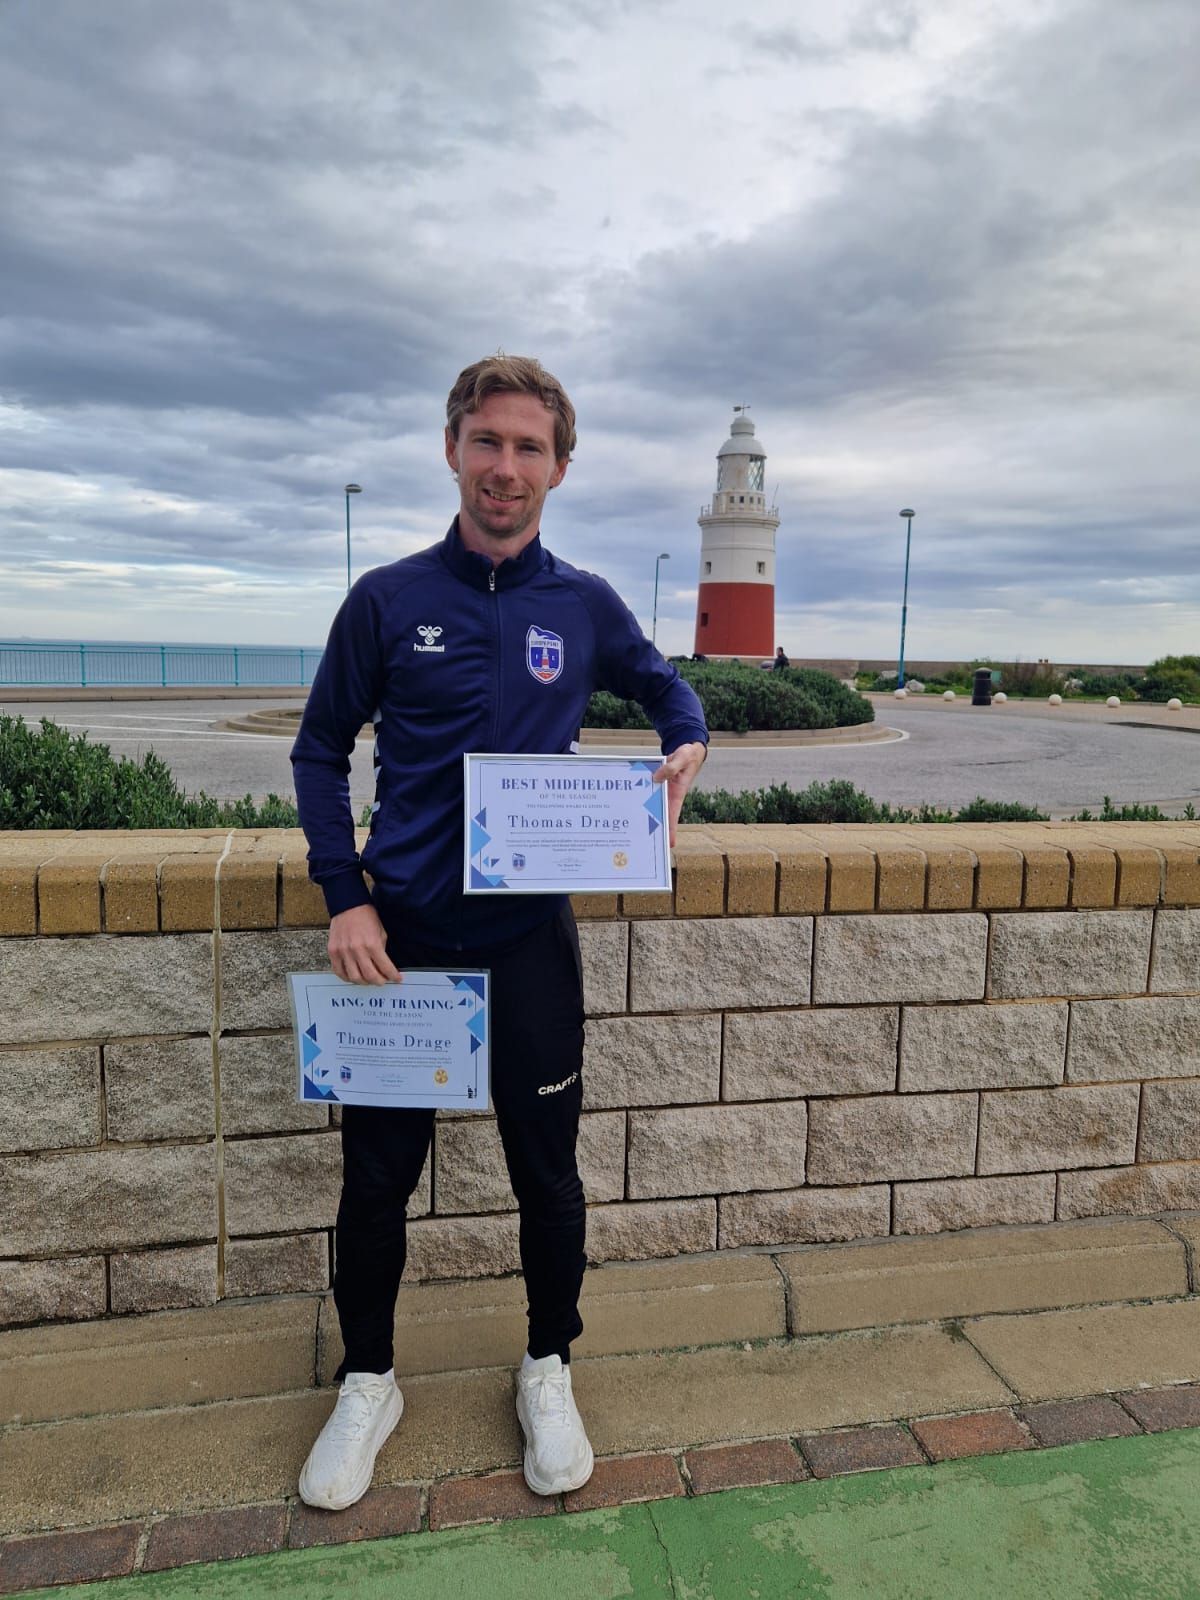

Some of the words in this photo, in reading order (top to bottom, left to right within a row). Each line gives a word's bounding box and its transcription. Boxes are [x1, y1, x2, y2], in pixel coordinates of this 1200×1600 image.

[413, 643, 445, 653] hummel
[501, 778, 538, 790] BEST
[544, 778, 632, 791] MIDFIELDER
[507, 815, 573, 828] Thomas
[581, 816, 630, 831] Drage
[331, 998, 364, 1008] KING
[369, 998, 385, 1008] OF
[391, 999, 453, 1010] TRAINING
[336, 1032, 395, 1047] Thomas
[403, 1034, 452, 1051] Drage
[537, 1076, 572, 1095] CRAFT
